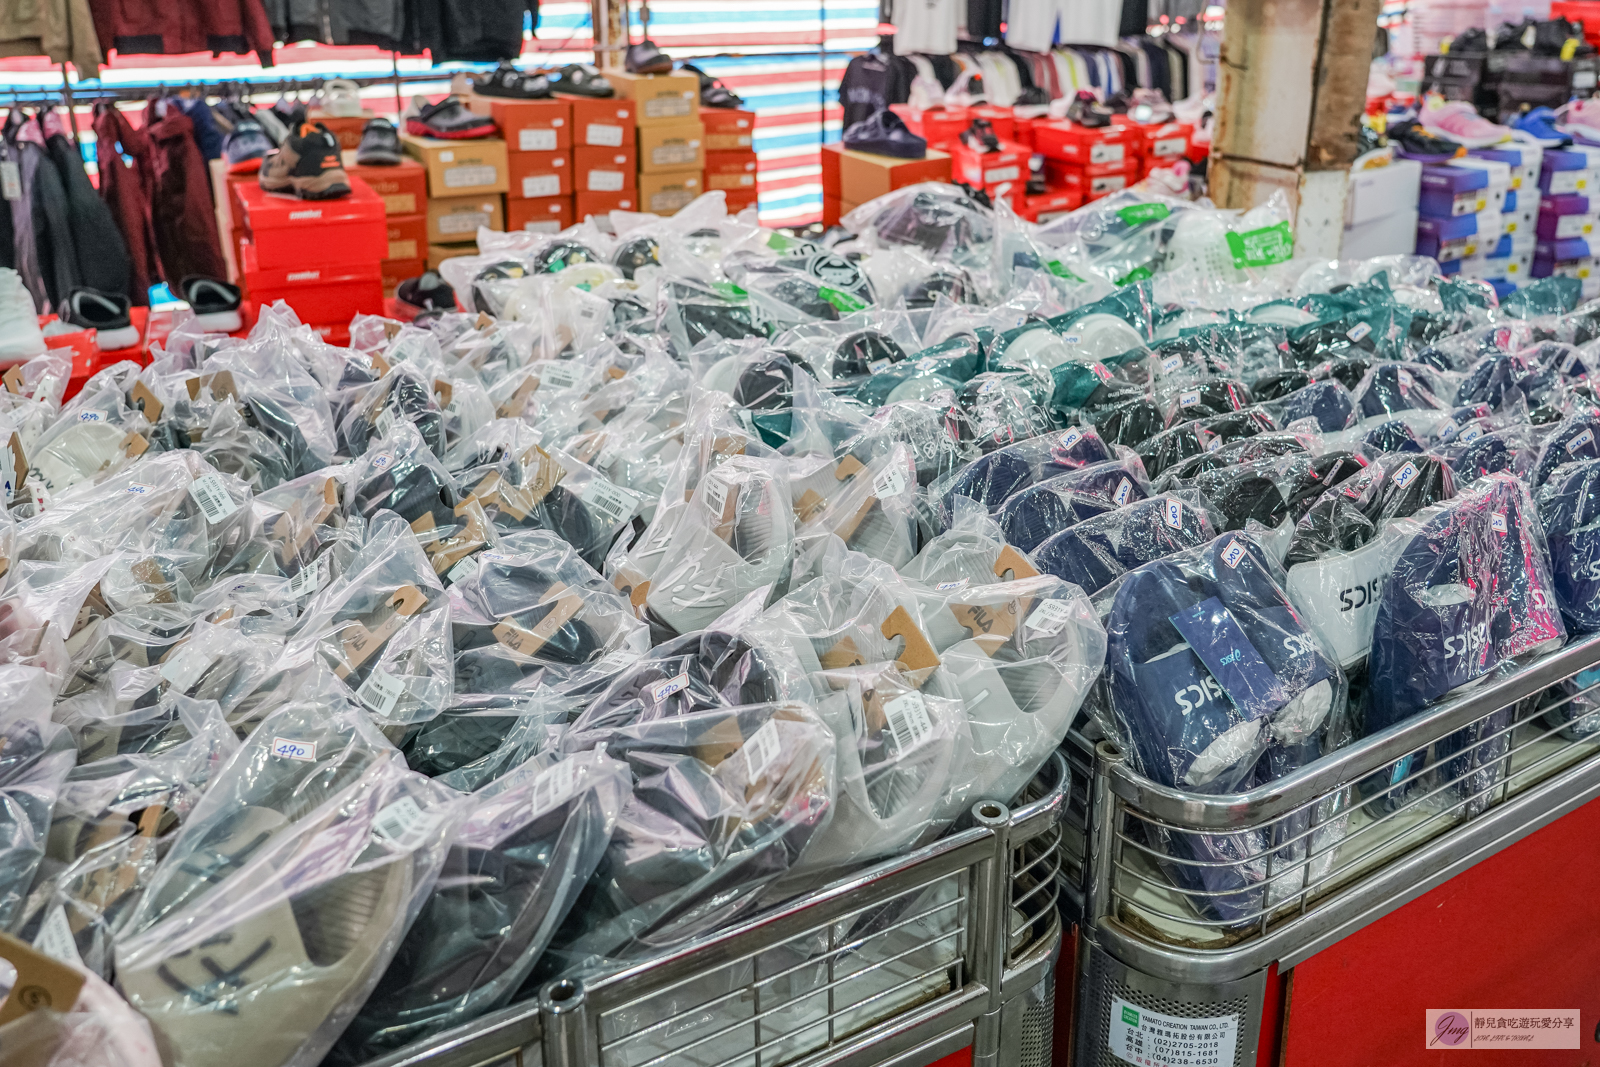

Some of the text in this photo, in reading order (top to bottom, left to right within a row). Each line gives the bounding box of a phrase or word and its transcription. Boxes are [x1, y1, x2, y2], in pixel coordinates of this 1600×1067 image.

[967, 605, 994, 634] FILA
[656, 683, 680, 699] 490
[277, 744, 305, 759] 490
[1141, 1014, 1162, 1026] YAMATO
[1162, 1020, 1188, 1030] CREATION
